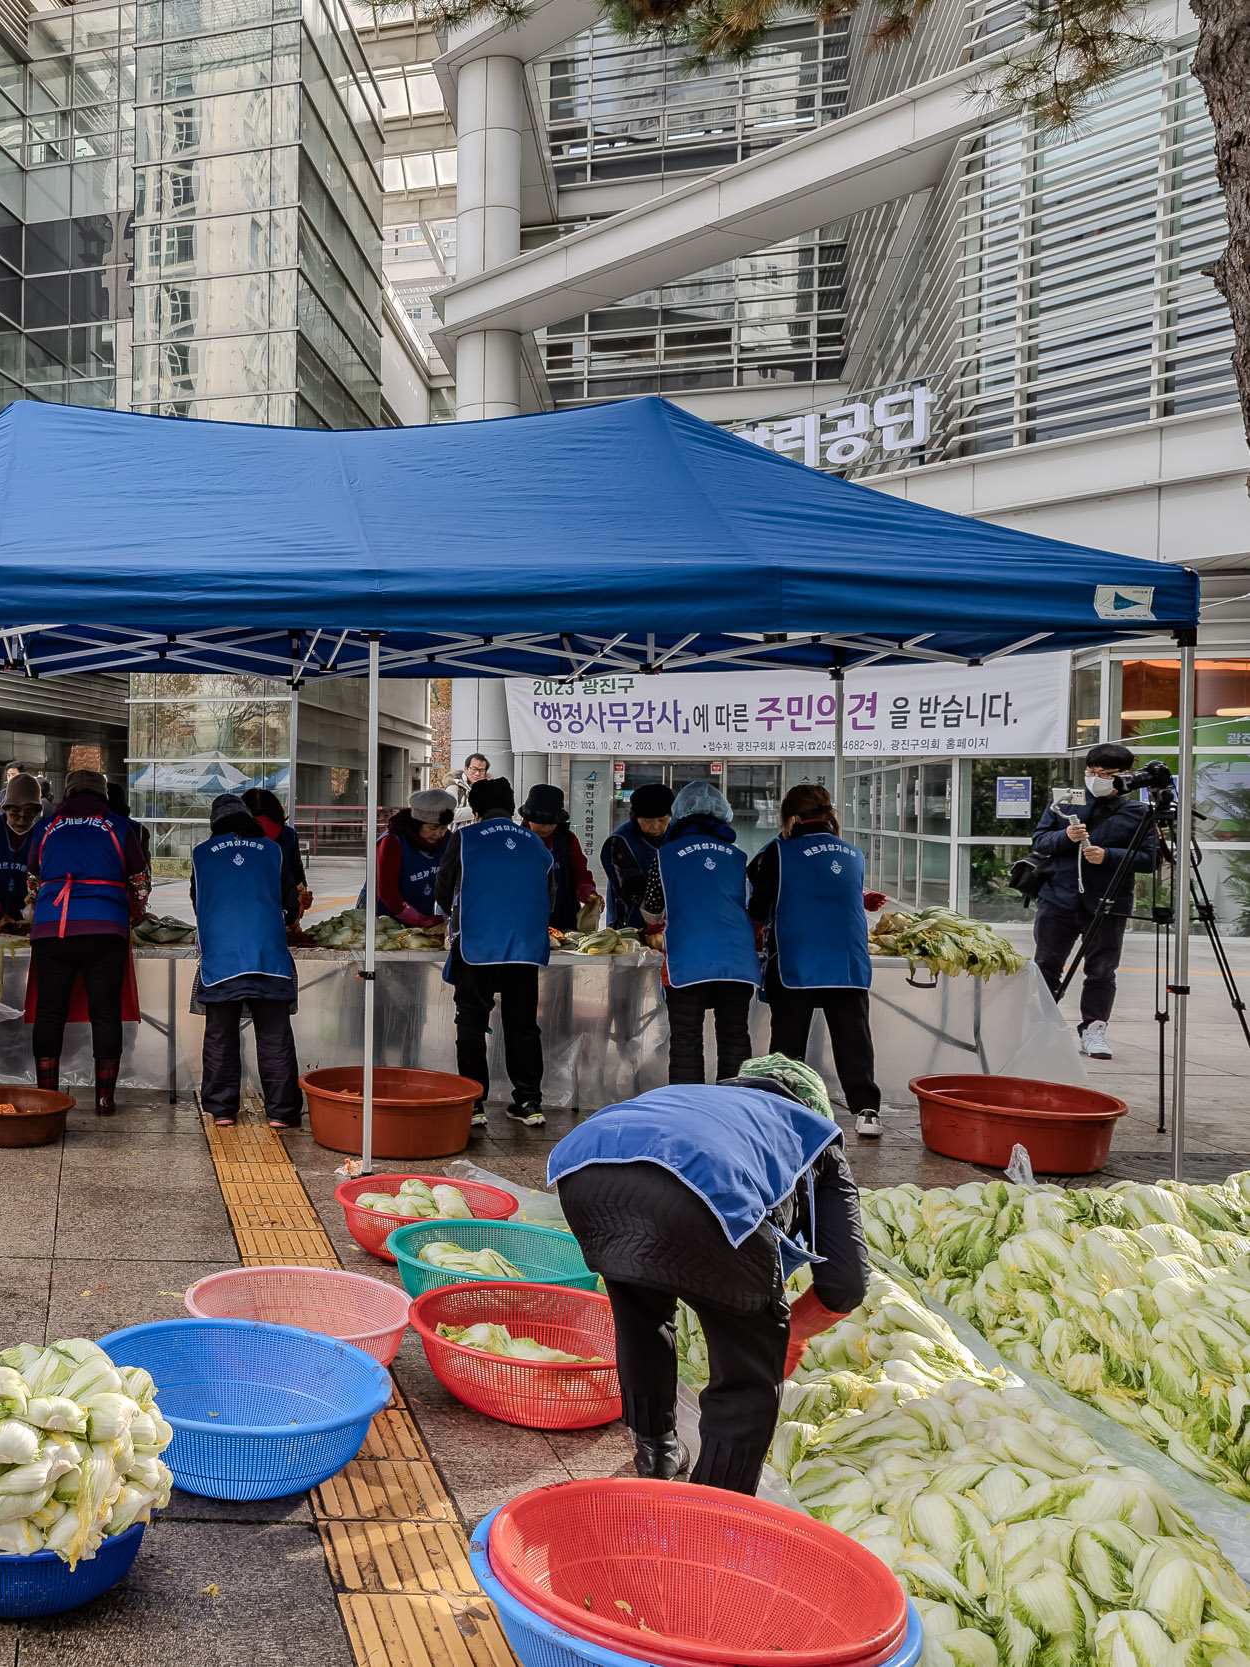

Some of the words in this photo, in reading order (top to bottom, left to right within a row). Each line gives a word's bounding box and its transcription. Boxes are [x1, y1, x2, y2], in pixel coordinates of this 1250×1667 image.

[533, 680, 575, 696] 2023
[582, 677, 635, 695] 광진구
[715, 703, 748, 733] 따른
[889, 696, 911, 730] 을
[919, 691, 1018, 729] 받습니다.
[580, 741, 598, 751] 2023.
[600, 741, 612, 751] 10.
[613, 741, 624, 751] 27.
[635, 741, 654, 751] 2023.
[657, 741, 667, 751] 11.
[669, 741, 680, 751] 17.
[736, 740, 776, 752] 광진구의회
[890, 738, 940, 751] 광진구의회
[945, 737, 989, 750] 홈페이지
[211, 839, 265, 853] 바르게살기운동
[677, 842, 734, 857] 바르게살기운동
[803, 844, 857, 858] 바르게살기운동
